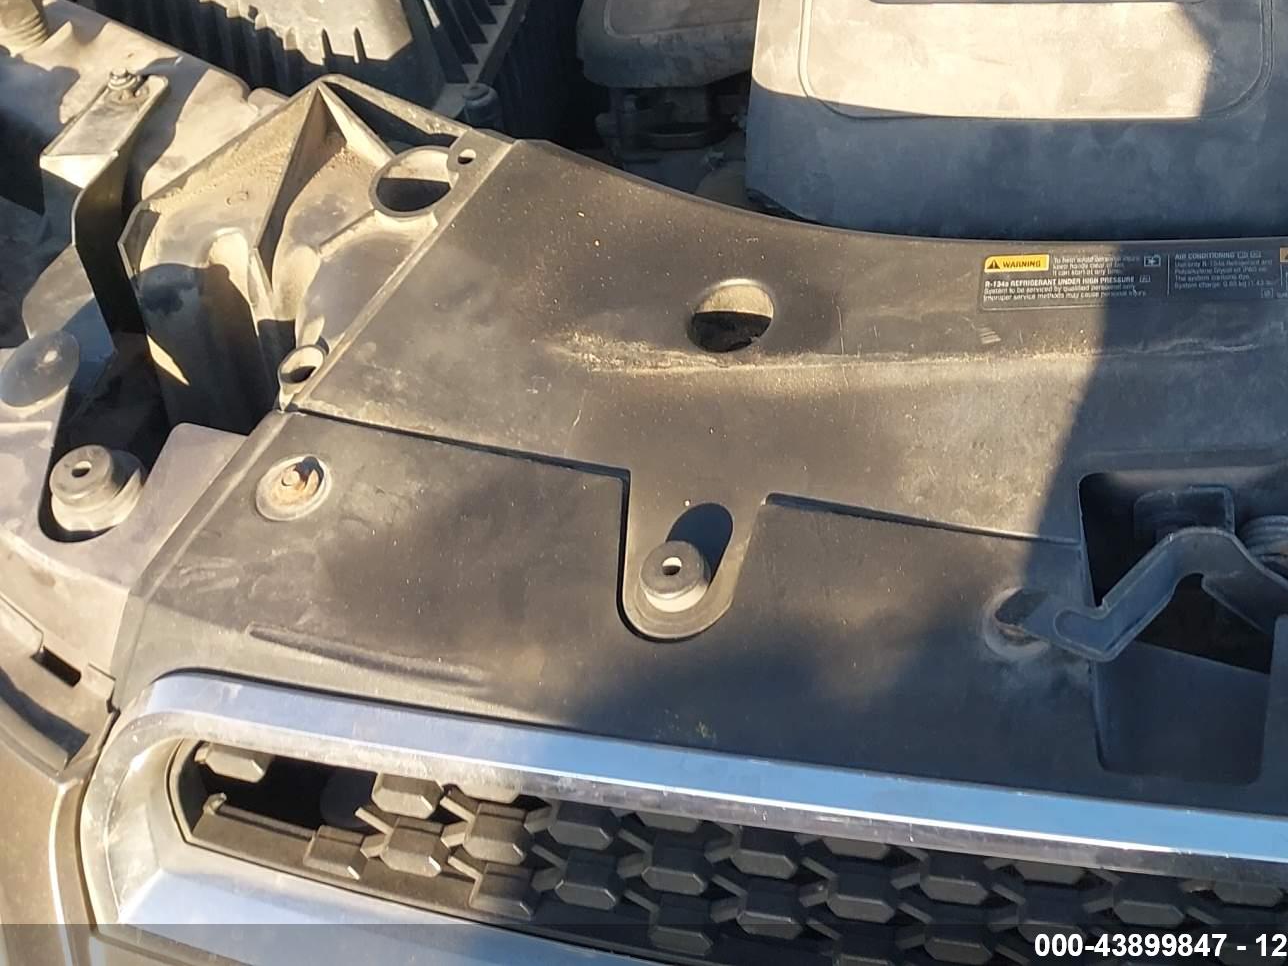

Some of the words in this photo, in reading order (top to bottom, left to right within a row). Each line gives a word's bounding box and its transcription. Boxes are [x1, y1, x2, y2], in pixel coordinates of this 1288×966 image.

[1002, 259, 1041, 268] WARNING
[1010, 278, 1057, 287] REFRIGERANT
[1058, 277, 1081, 285] UNDER
[1082, 276, 1099, 284] HIGH
[1100, 275, 1135, 284] PRESSURE
